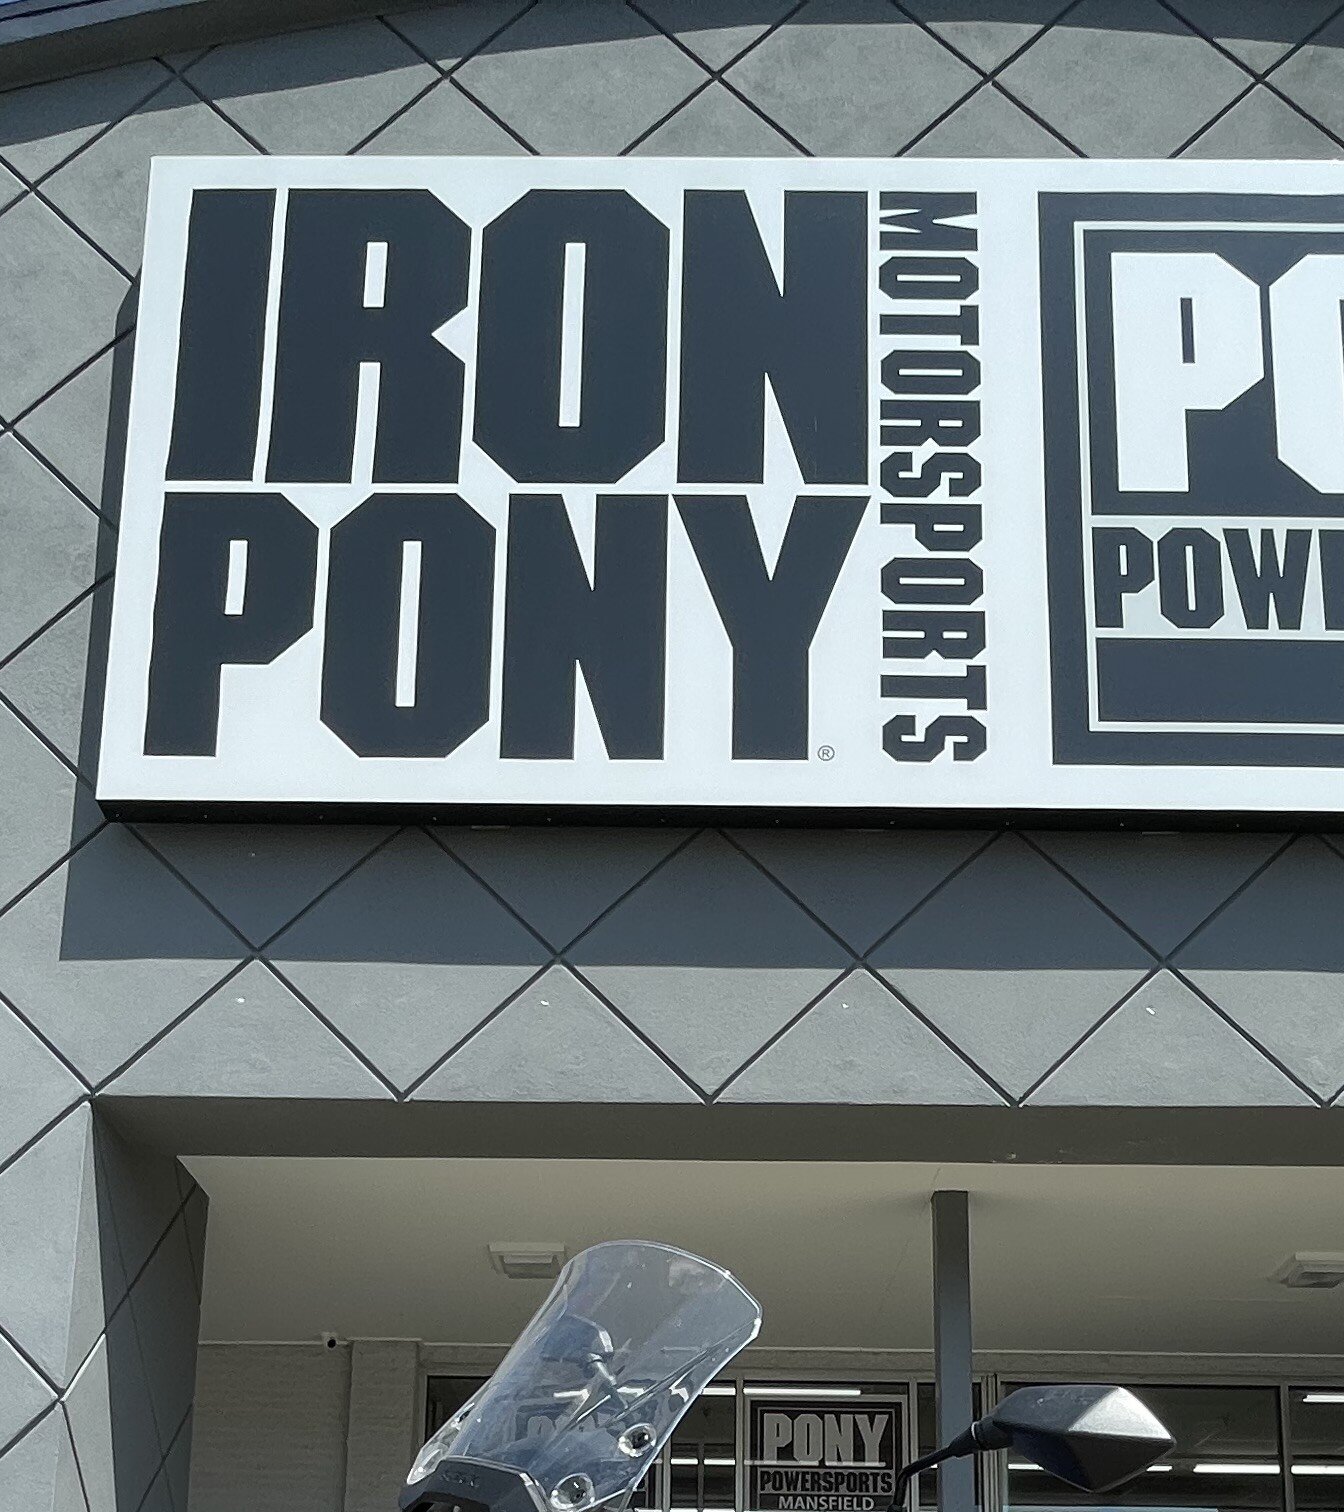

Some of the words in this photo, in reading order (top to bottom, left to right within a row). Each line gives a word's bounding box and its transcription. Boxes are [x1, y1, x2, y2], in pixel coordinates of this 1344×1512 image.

[164, 187, 870, 486] IRON
[878, 190, 988, 764] MOTORSPORTS
[143, 490, 872, 762] PONY
[759, 1469, 894, 1494] POWERSPORTS
[763, 1412, 891, 1467] PONY
[777, 1494, 875, 1511] MANSFIELD
